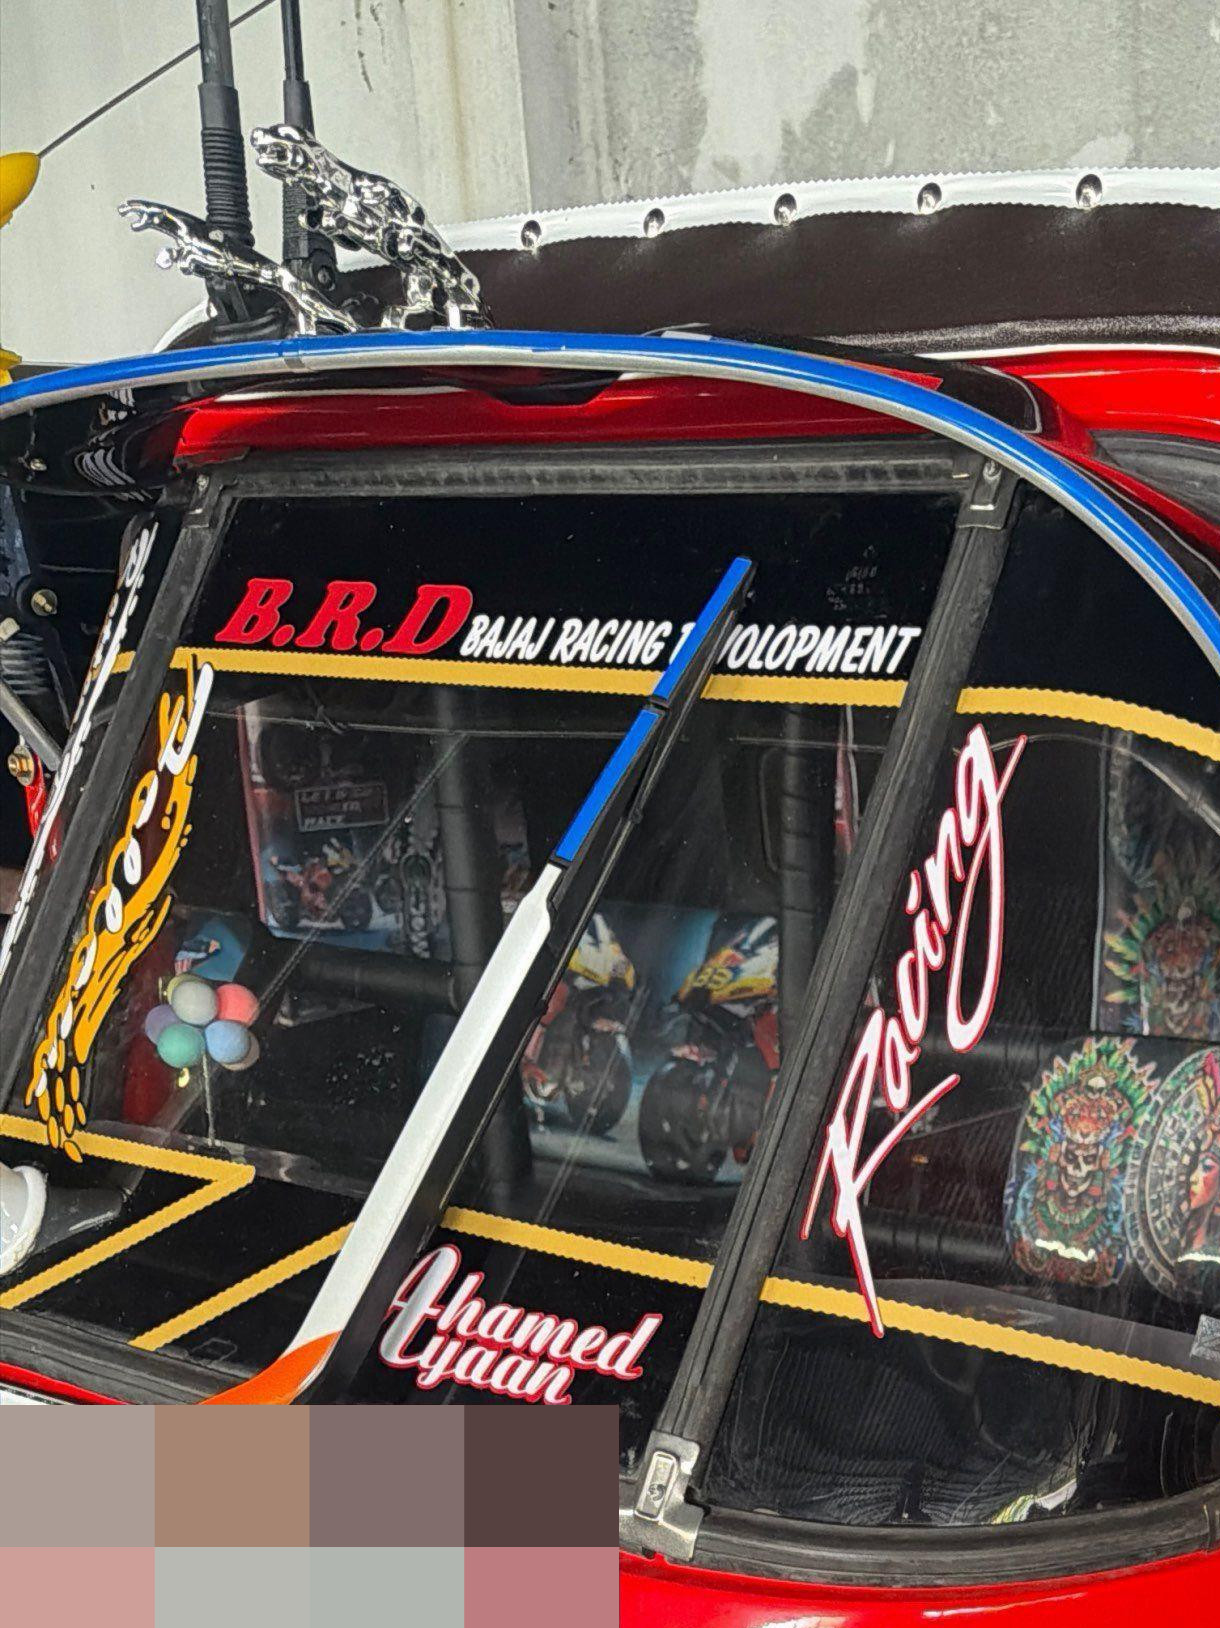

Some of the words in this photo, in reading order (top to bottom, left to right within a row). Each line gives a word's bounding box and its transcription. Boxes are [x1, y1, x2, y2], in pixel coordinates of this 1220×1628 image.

[214, 577, 473, 655] B.R.D
[458, 614, 556, 662] BAJAJ
[549, 616, 674, 665] RACING
[668, 621, 922, 675] OLOPMENT
[800, 723, 1028, 1338] Racing
[378, 1243, 664, 1381] Ahamed
